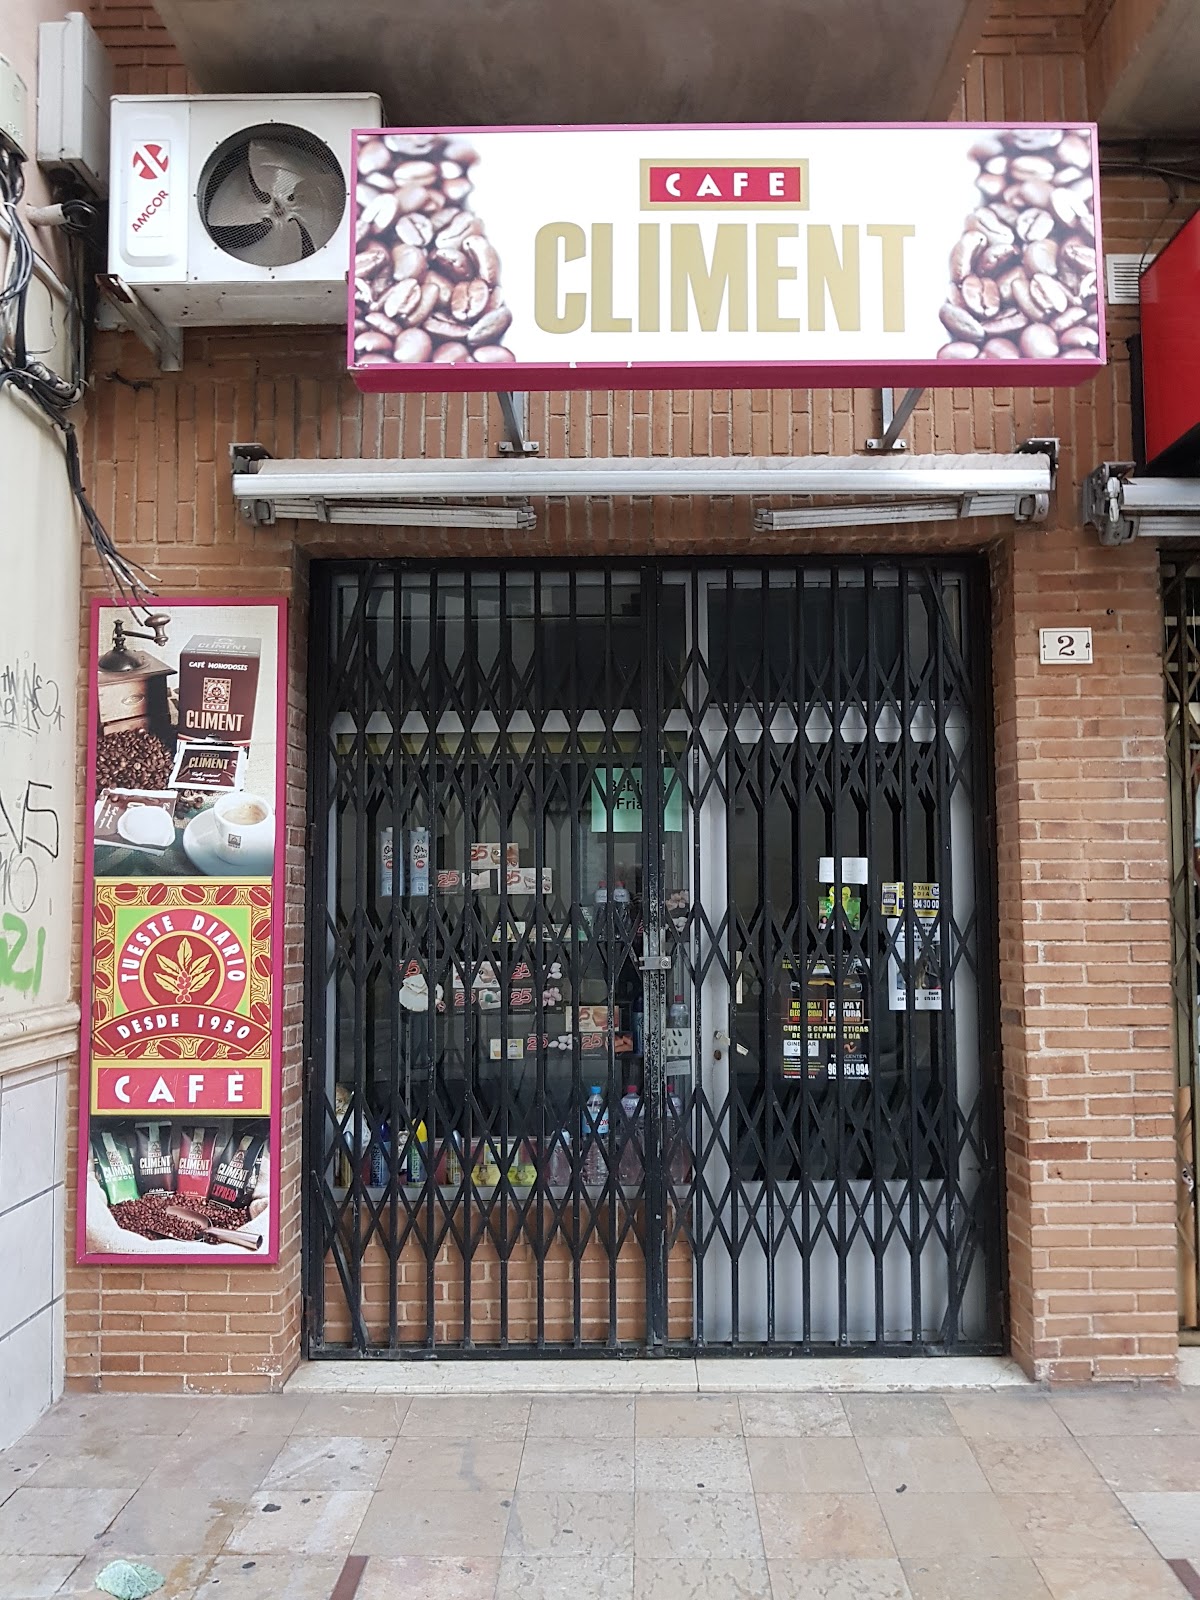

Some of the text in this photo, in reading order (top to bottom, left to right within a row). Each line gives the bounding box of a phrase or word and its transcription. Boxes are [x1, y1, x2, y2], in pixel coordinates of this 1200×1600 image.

[665, 172, 785, 197] CAFE
[132, 190, 169, 232] AMCOR
[534, 221, 916, 334] CLIMENT
[1057, 635, 1075, 656] 2
[207, 661, 248, 671] MONODOSIS
[186, 709, 245, 732] CLIMENT
[188, 756, 229, 770] CLIMENT
[437, 870, 460, 888] 25
[121, 914, 246, 983] TUESTE DIARIO
[510, 988, 533, 1006] 25
[116, 1013, 251, 1039] DESDE 1950
[102, 1163, 135, 1179] CLIMENT
[139, 1155, 171, 1169] CLIMENT
[179, 1158, 210, 1171] CLIMENT
[217, 1162, 249, 1182] CLIMENT
